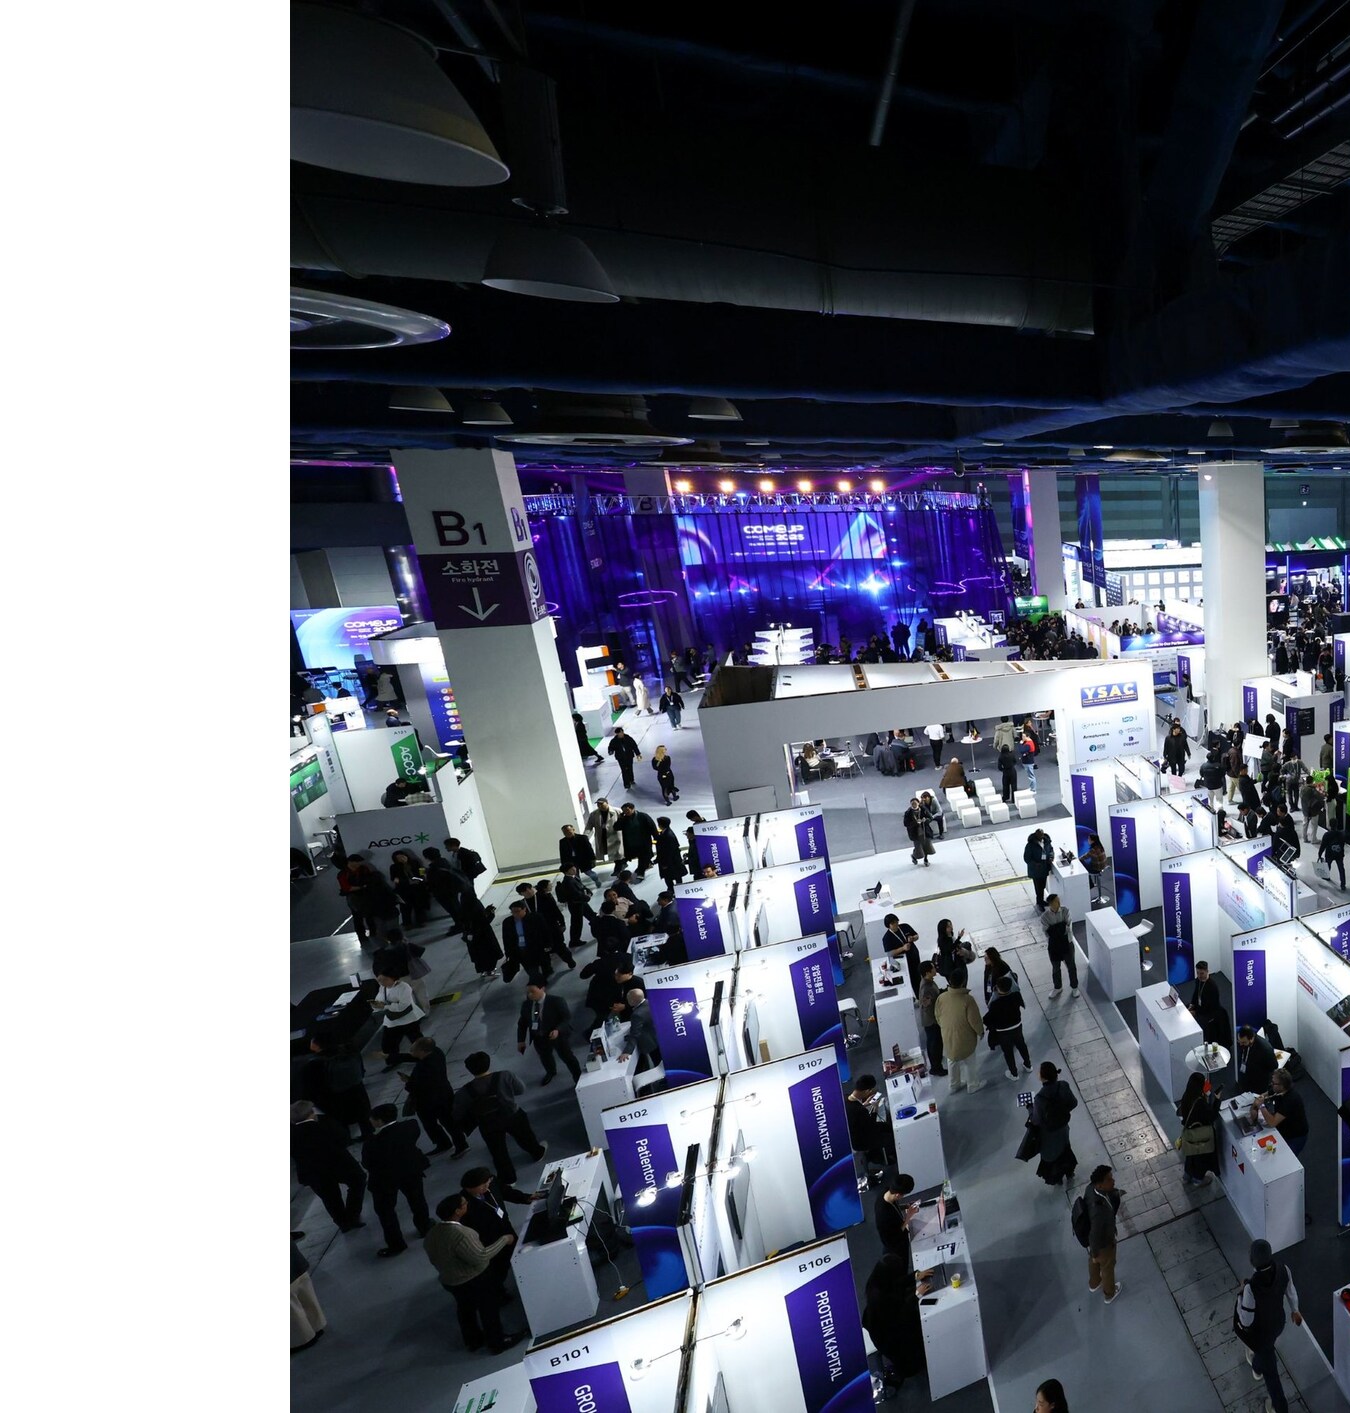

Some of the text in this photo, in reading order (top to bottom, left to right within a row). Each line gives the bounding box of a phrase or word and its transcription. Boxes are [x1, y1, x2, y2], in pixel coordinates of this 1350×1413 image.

[432, 510, 487, 546] B1
[511, 507, 528, 542] B1
[441, 559, 500, 575] 소화전
[344, 619, 398, 629] COMEUP
[1083, 683, 1136, 700] YSAC
[399, 745, 417, 776] AGCC
[368, 836, 412, 849] AGCC
[1119, 824, 1128, 848] Daylight
[685, 887, 704, 895] B104
[808, 884, 821, 914] HABSIDA
[694, 907, 707, 940] ArbaLabs
[797, 943, 817, 952] B108
[1241, 937, 1257, 946] B112
[1341, 931, 1349, 949] 21st
[656, 974, 679, 985] B103
[812, 964, 825, 994] 창업진흥원
[1246, 960, 1254, 986] Rangle
[802, 966, 815, 1006] STARTUP KOREA
[669, 998, 687, 1037] KONNECT
[798, 1058, 823, 1071] B107
[619, 1108, 648, 1123] B102
[811, 1086, 833, 1160] INSIGHTMATCHES
[798, 1254, 832, 1273] B106
[815, 1290, 843, 1382] PROTEIN KAPITAL
[550, 1345, 590, 1367] B101
